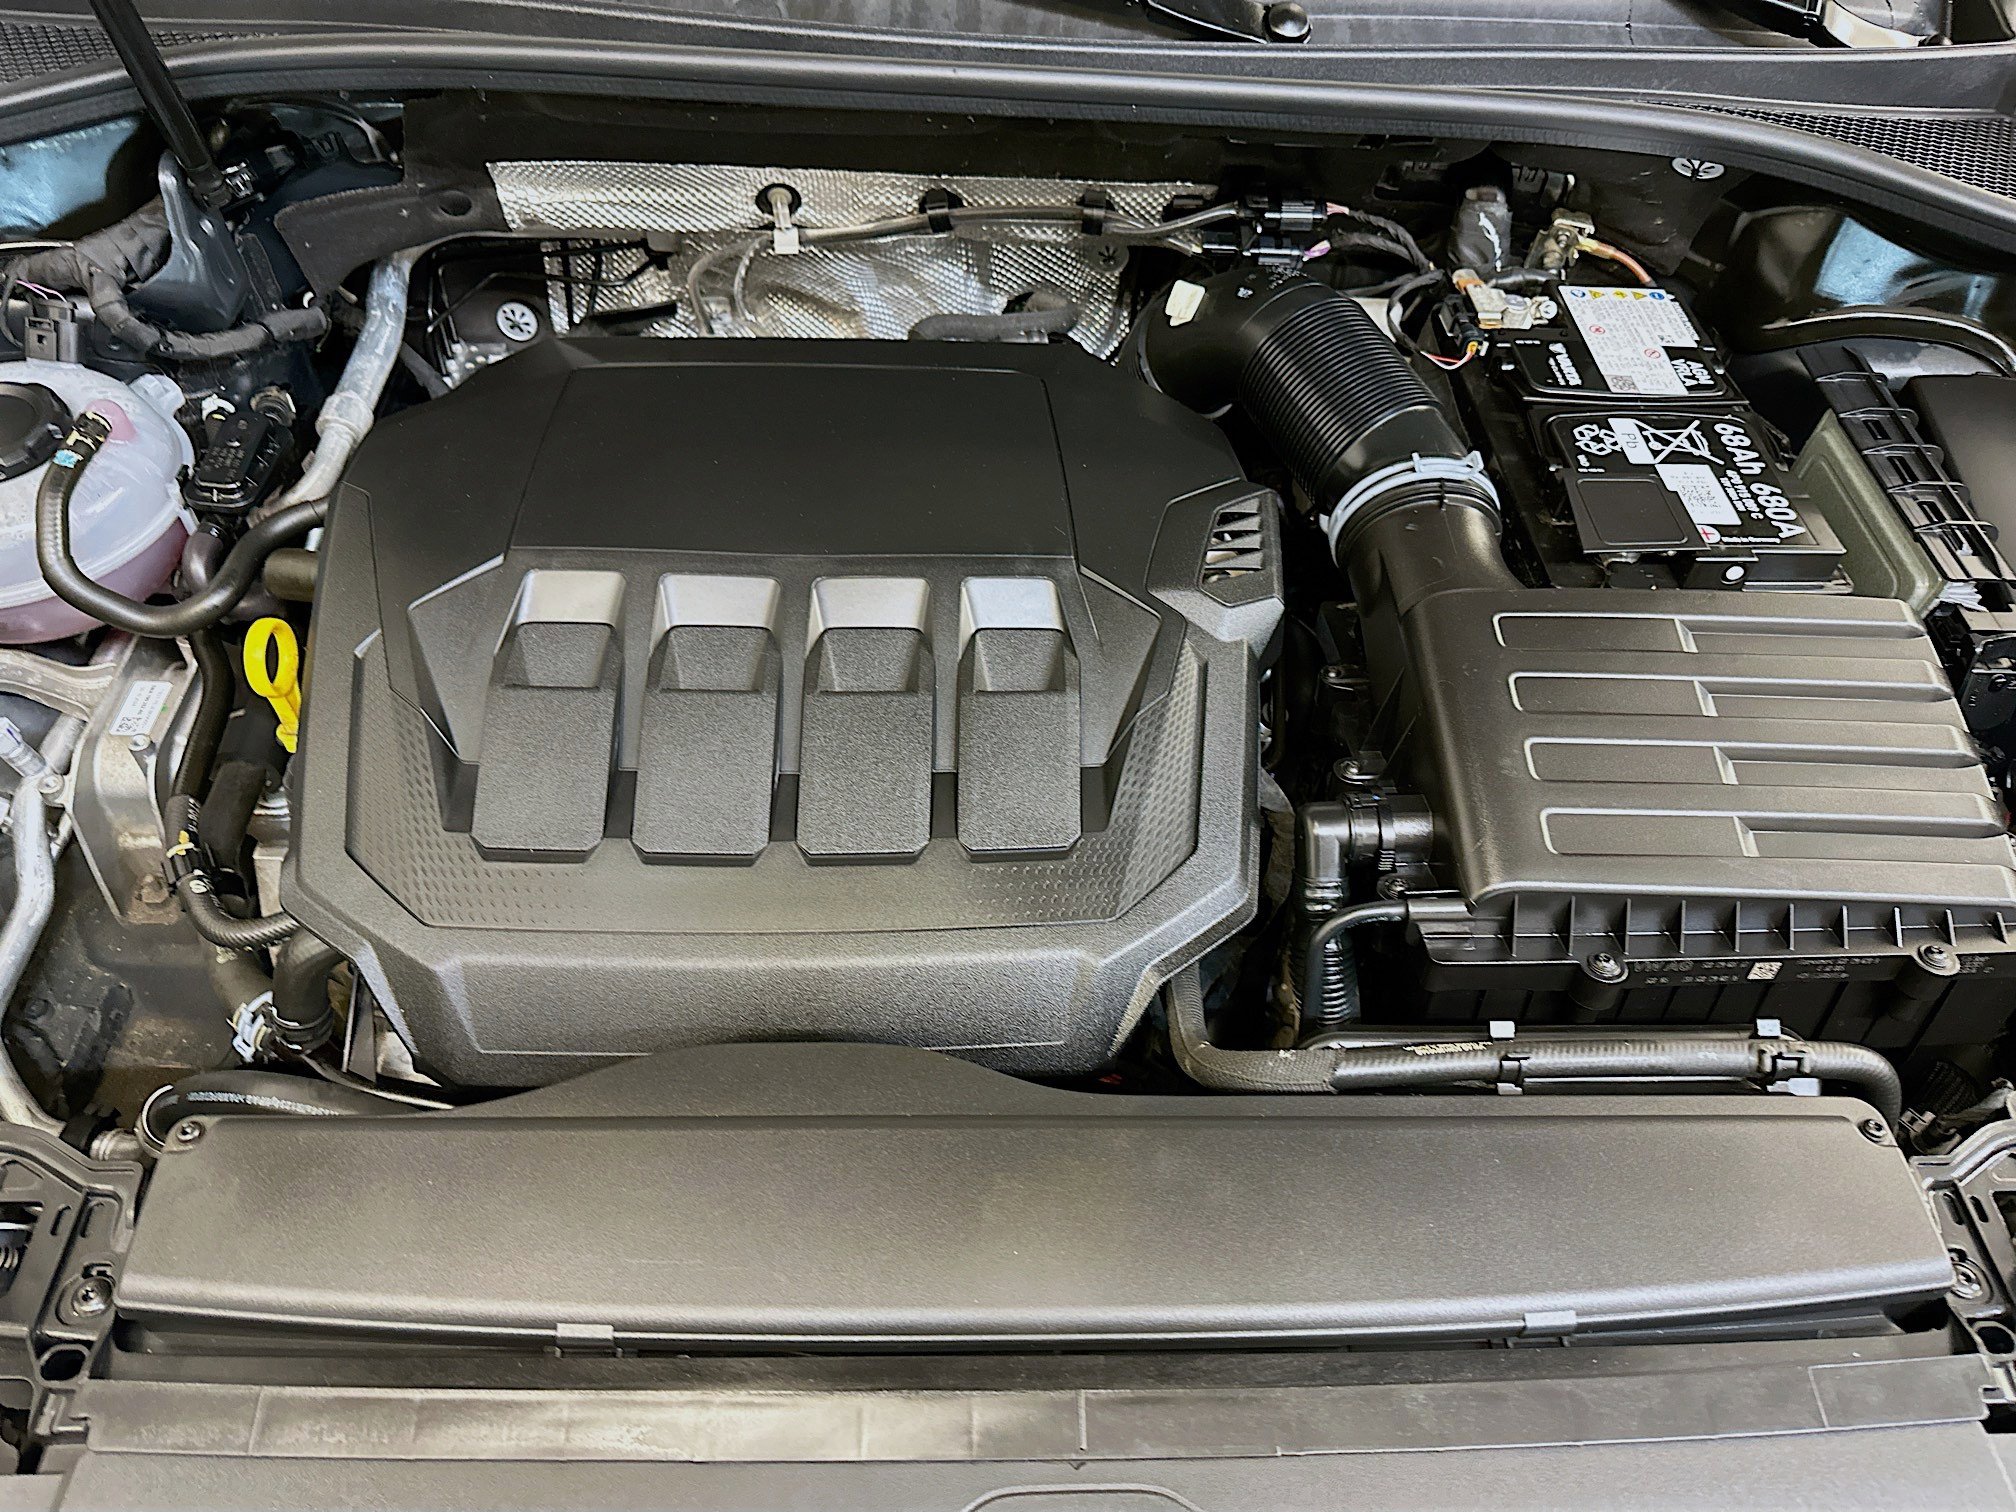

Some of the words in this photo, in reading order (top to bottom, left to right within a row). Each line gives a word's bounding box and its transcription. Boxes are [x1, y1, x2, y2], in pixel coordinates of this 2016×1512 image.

[1671, 359, 1698, 386] VRLA
[1621, 432, 1638, 449] Pb
[1714, 423, 1766, 474] 68Ah
[1750, 483, 1806, 538] 680A
